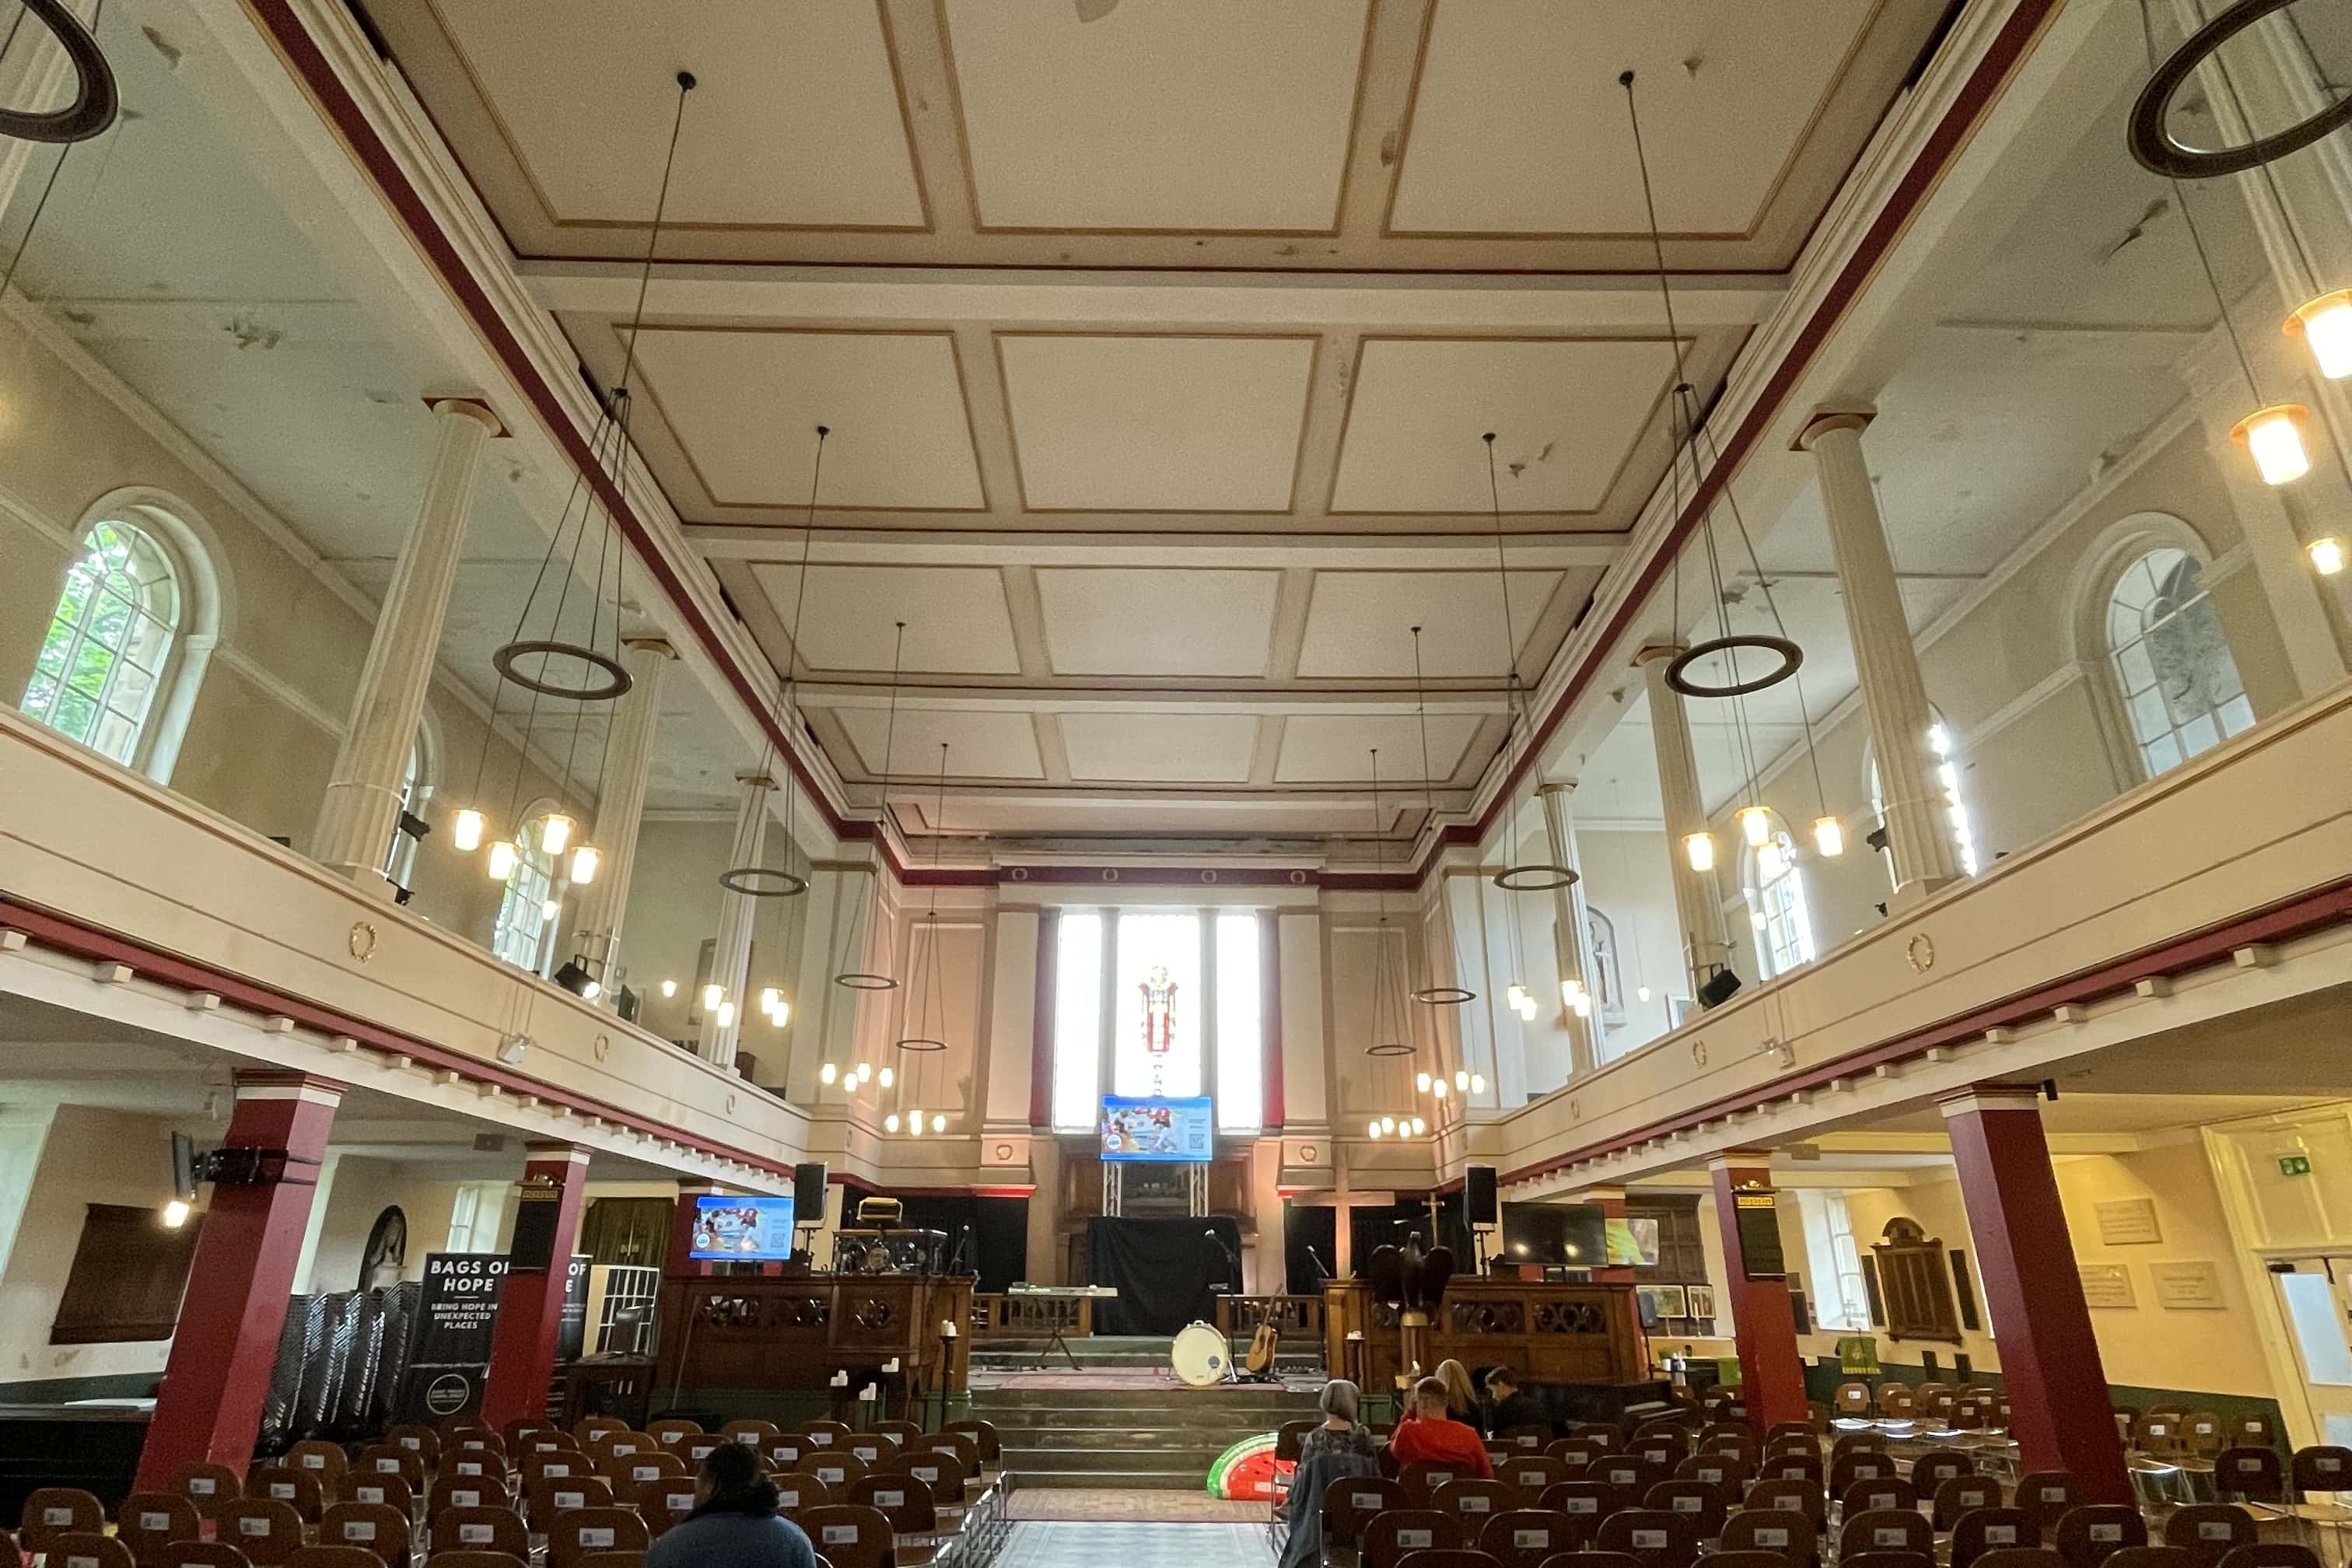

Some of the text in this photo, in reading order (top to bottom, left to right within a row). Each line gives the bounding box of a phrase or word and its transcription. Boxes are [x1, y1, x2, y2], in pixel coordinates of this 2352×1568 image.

[430, 1261, 481, 1275] BAGS
[569, 1262, 587, 1276] OF
[443, 1278, 495, 1291] HOPE
